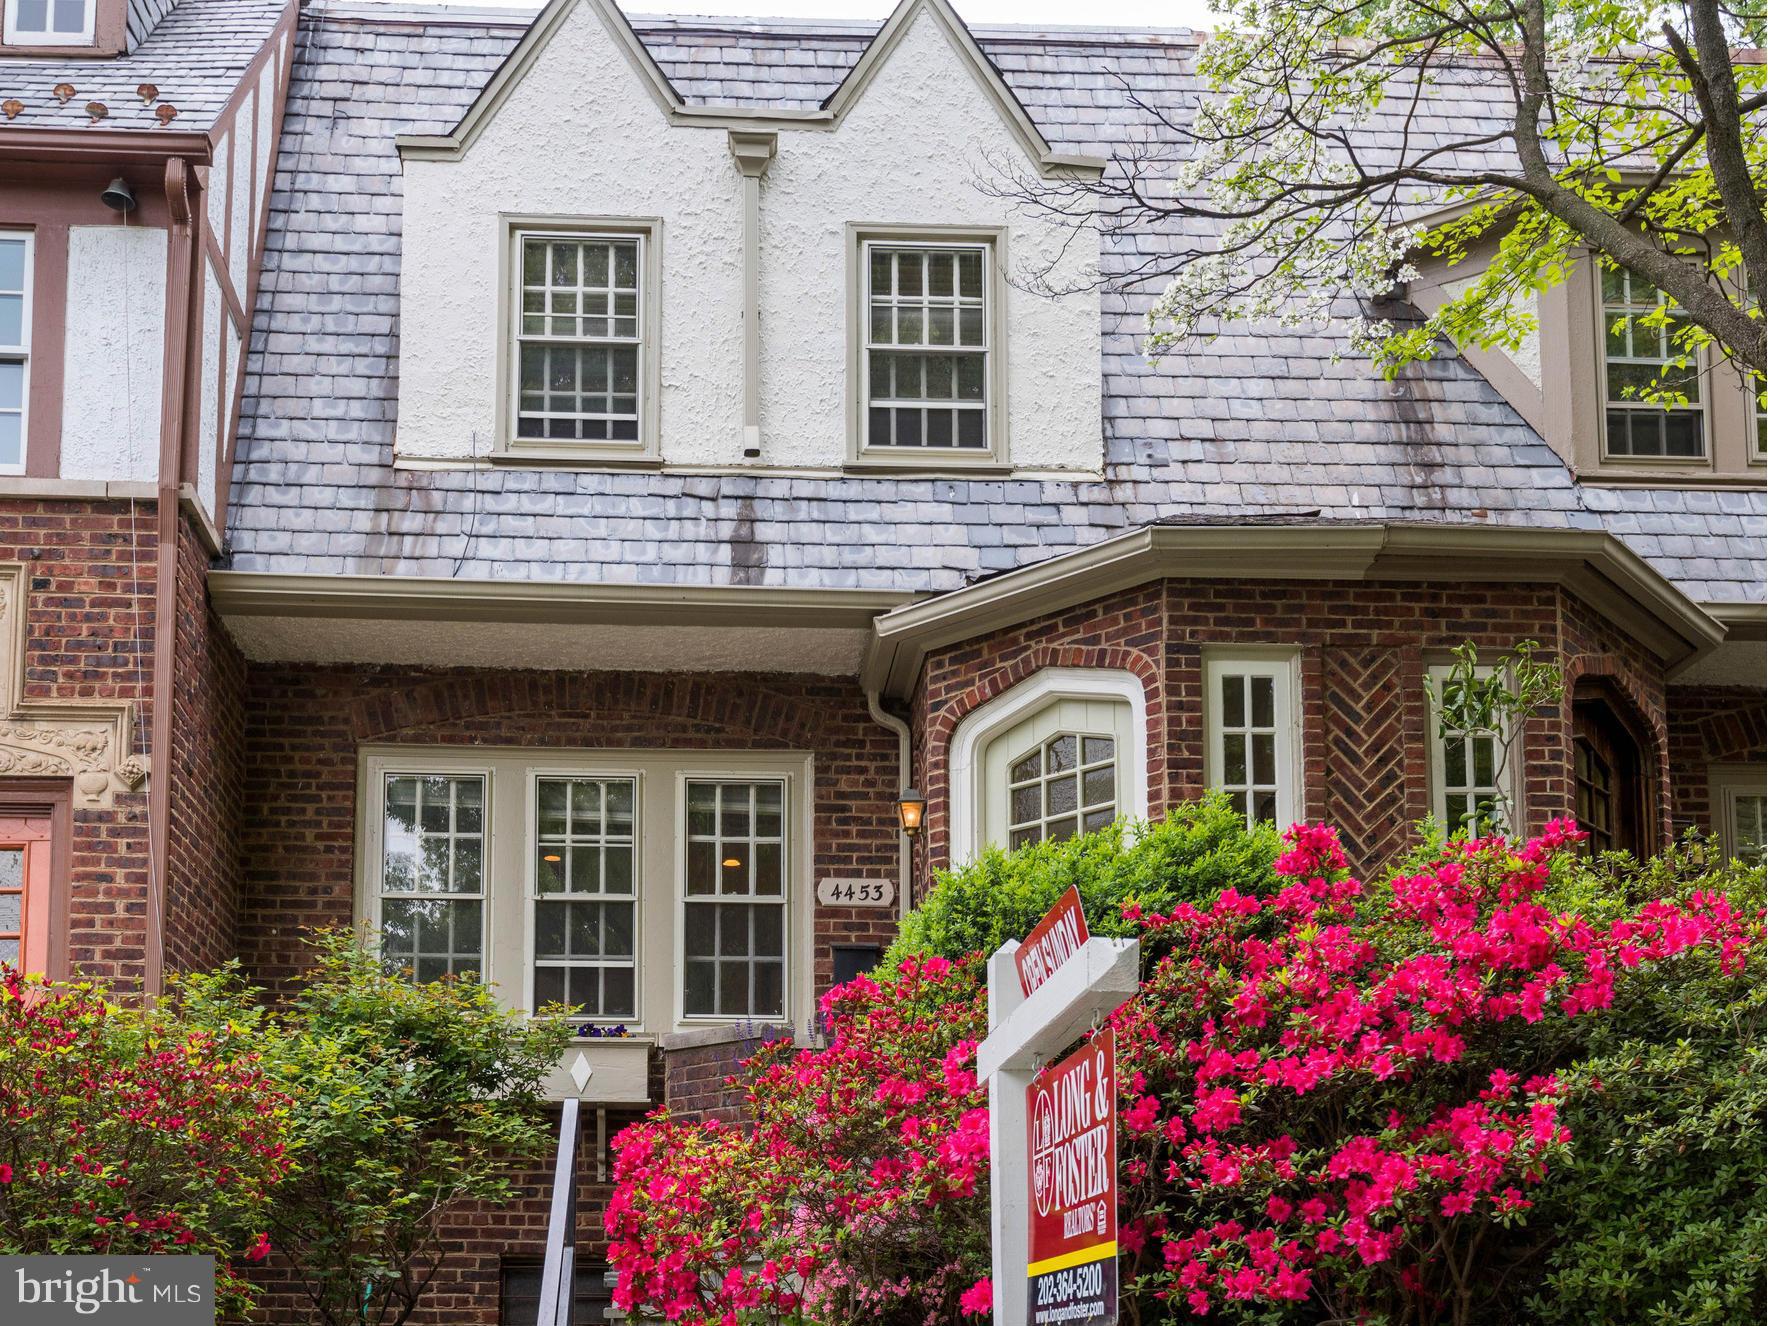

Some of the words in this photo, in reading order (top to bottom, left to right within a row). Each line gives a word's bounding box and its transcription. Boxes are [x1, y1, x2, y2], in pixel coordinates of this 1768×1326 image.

[831, 883, 883, 901] 4453
[1041, 905, 1079, 978] SUNDAY
[1053, 1059, 1091, 1143] LONG
[1095, 1050, 1109, 1121] &
[1055, 1125, 1109, 1211] FOSTER
[1037, 1262, 1103, 1305] 202-364-5200
[1035, 1301, 1105, 1325] www.longandfoster.com
